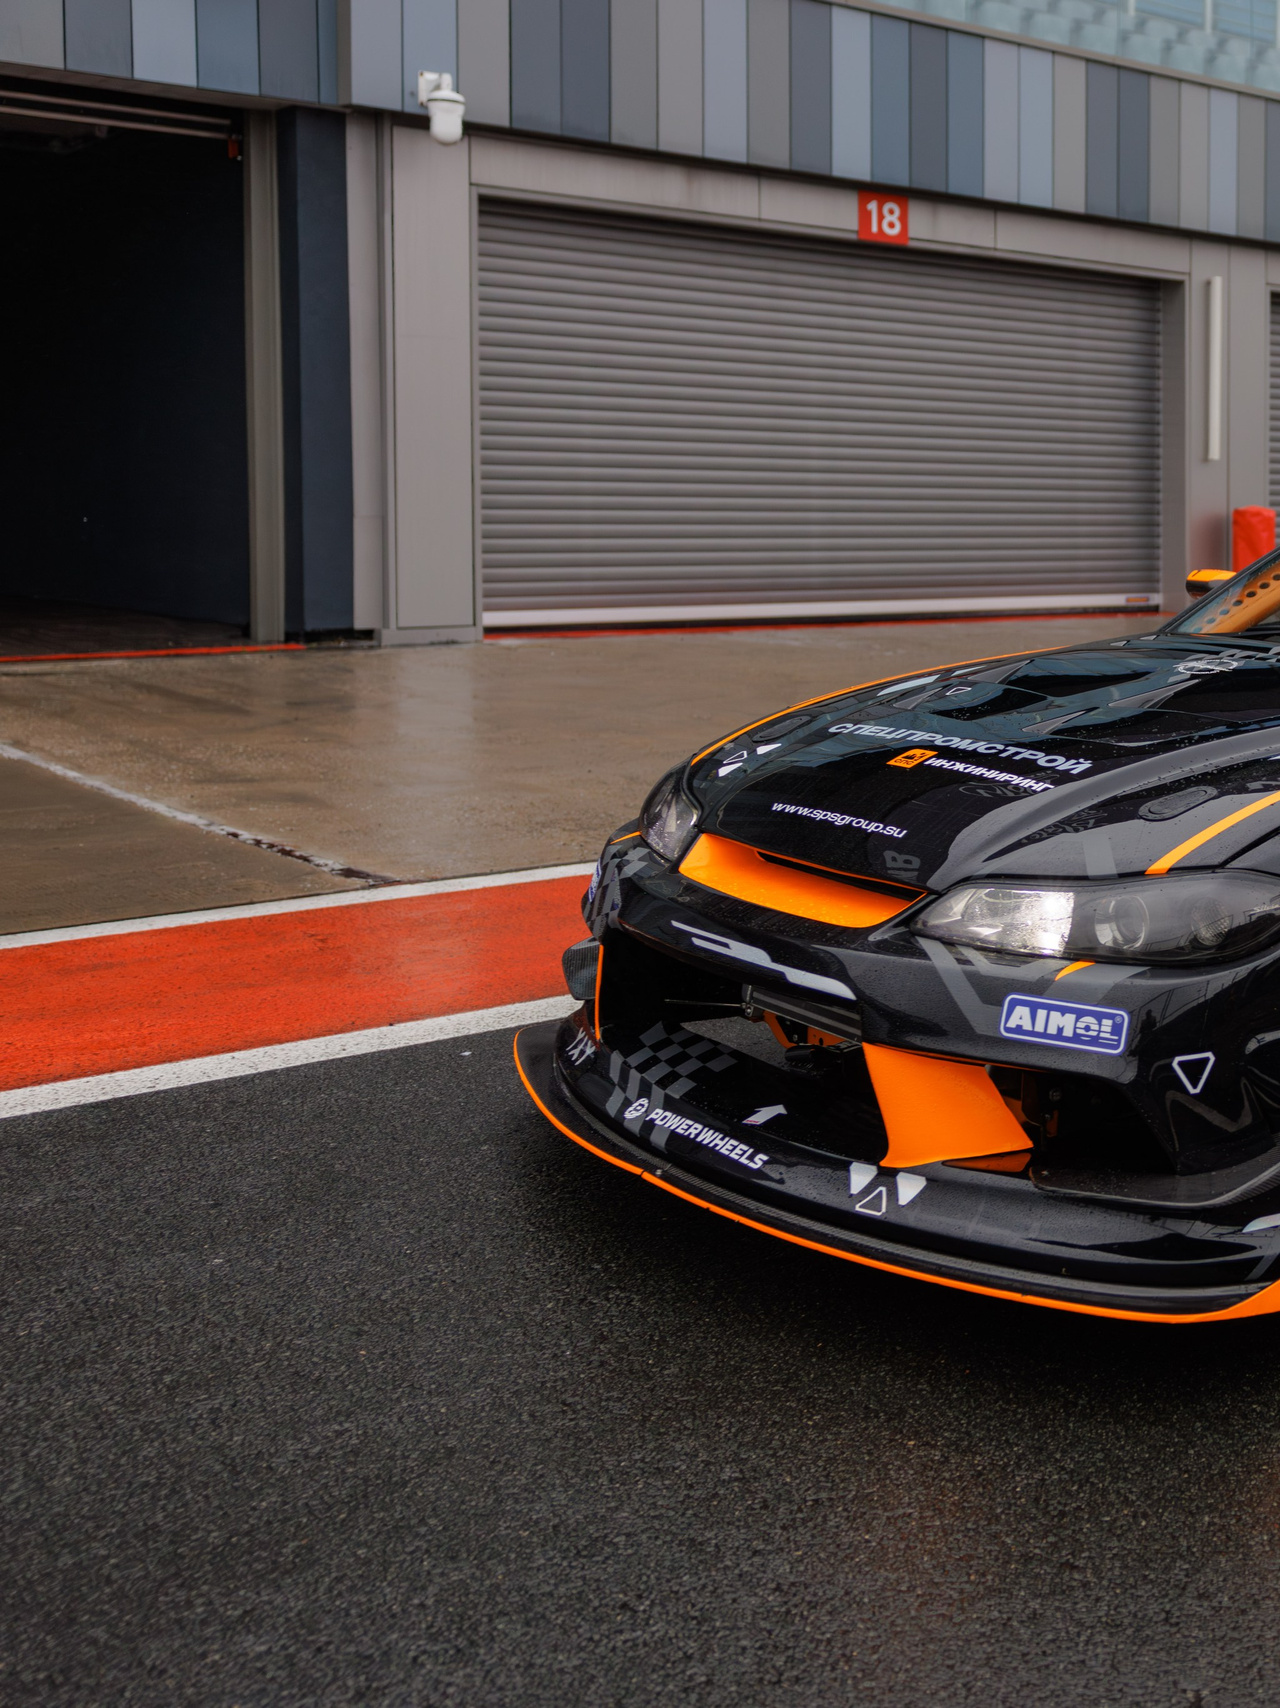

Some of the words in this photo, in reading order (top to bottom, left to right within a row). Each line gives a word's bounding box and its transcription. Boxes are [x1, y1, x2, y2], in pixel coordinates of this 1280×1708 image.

[865, 200, 901, 236] 18
[828, 723, 1093, 775] СПЕЦПРОМСТРОЙ
[923, 757, 1055, 792] ИНЖИНИРИНГ
[771, 802, 908, 838] www.spsgroup.su
[1005, 1005, 1119, 1045] AIMOL
[646, 1108, 770, 1169] POWERWHEELS
